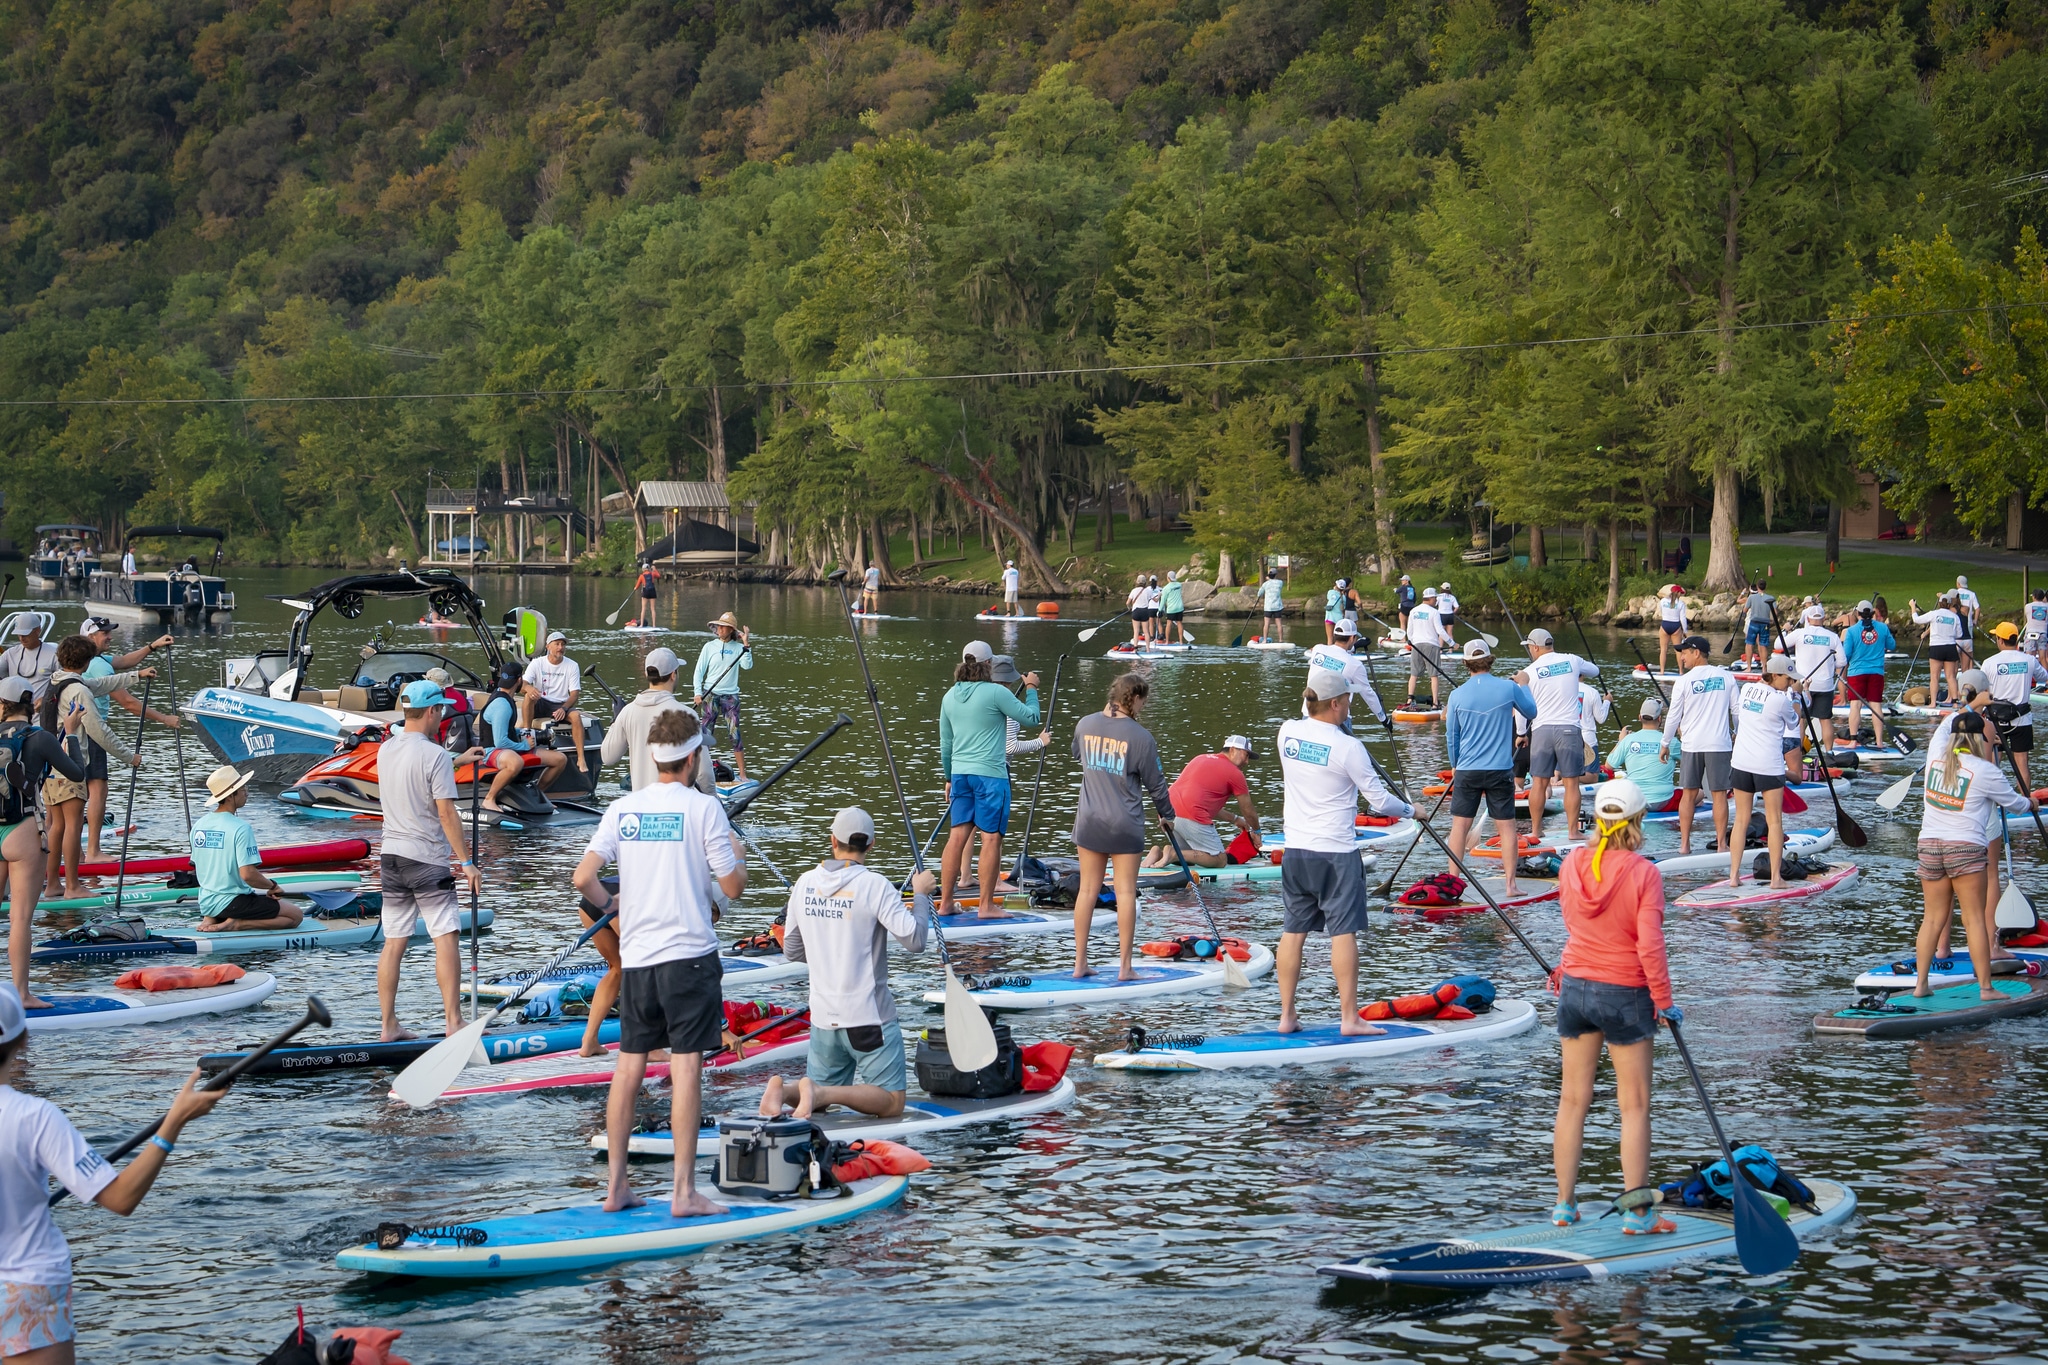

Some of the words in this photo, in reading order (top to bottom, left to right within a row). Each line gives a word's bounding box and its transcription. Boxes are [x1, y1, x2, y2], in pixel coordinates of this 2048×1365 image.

[228, 663, 234, 674] 2
[1745, 686, 1771, 703] ROXY
[1084, 734, 1128, 771] TYLER'S
[805, 896, 827, 907] DAM
[829, 898, 854, 909] THAT
[805, 907, 843, 919] CANCER
[286, 936, 319, 950] ISLE
[282, 1055, 333, 1068] thrive
[338, 1052, 370, 1064] 10.3
